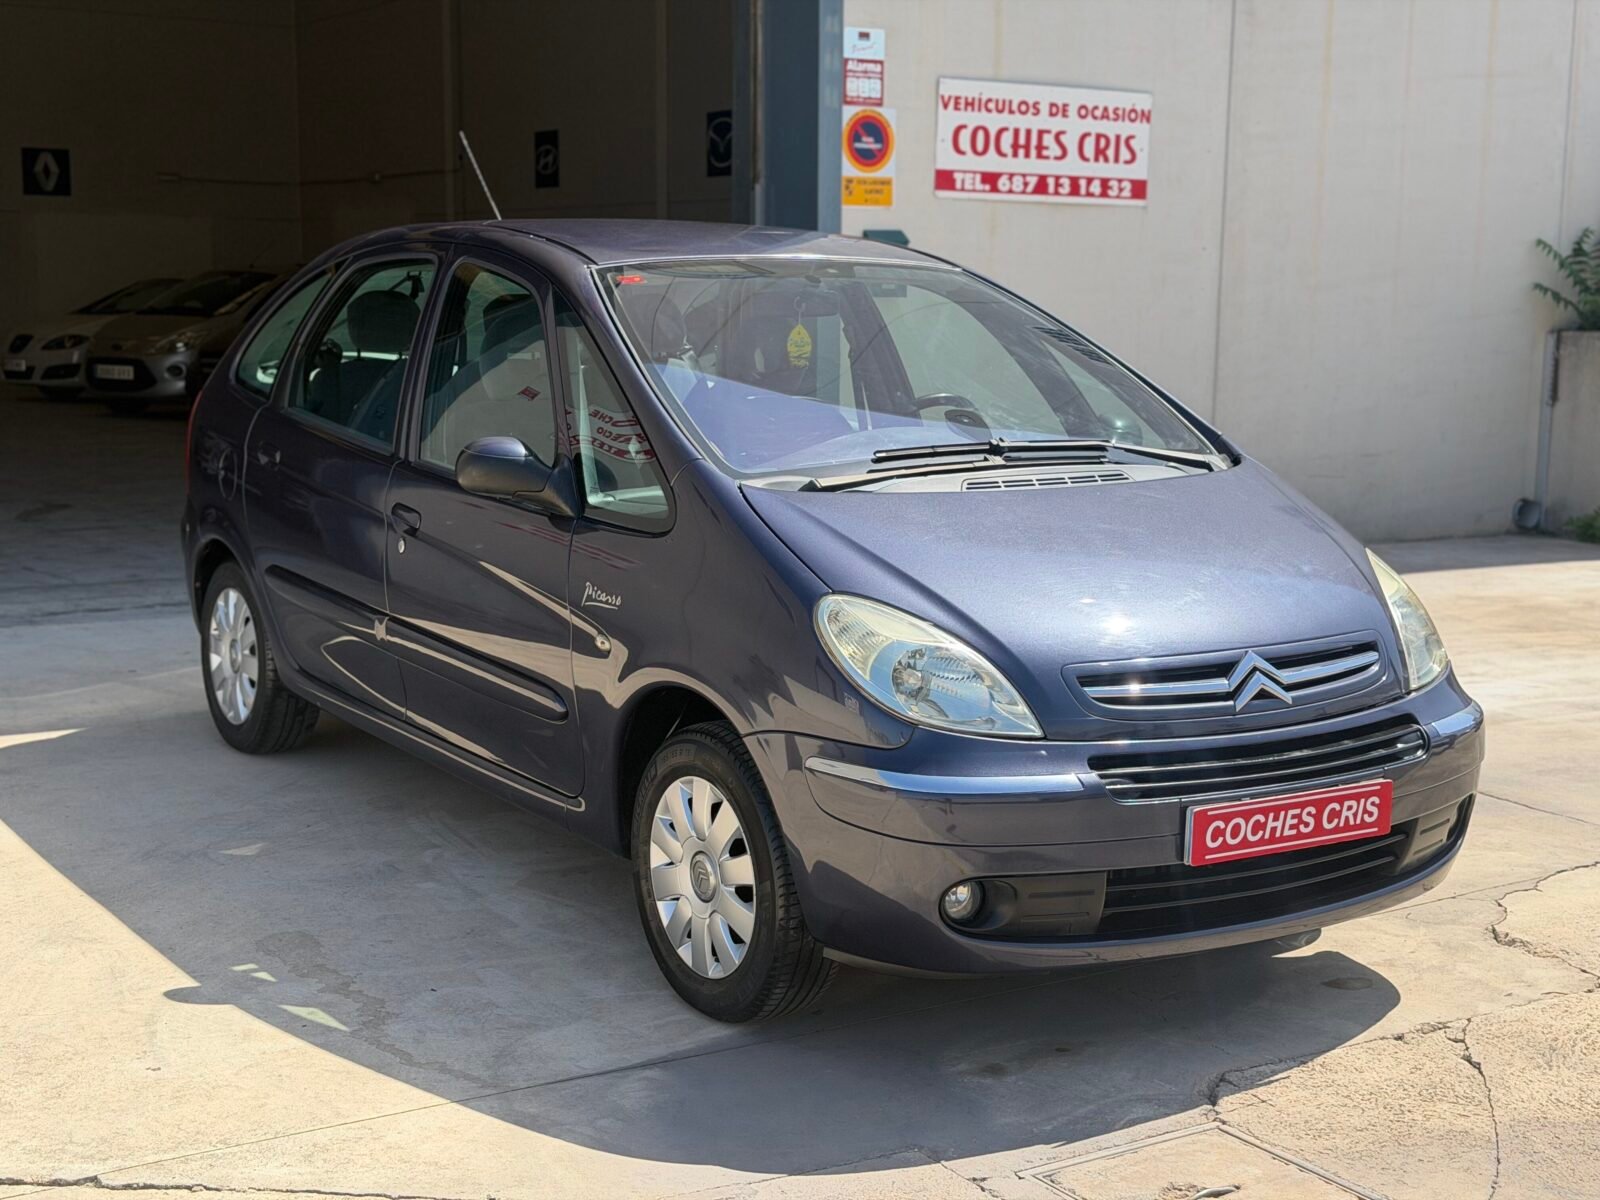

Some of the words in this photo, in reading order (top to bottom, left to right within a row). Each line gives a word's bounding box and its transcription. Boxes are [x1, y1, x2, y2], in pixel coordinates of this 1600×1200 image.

[940, 92, 1041, 117] VEHÍCULOS
[1048, 102, 1070, 119] DE
[1077, 103, 1152, 125] OCASIÓN
[952, 124, 1068, 161] COCHES
[1077, 132, 1138, 165] CRIS
[953, 172, 991, 192] TEL.
[997, 174, 1039, 194] 687
[1046, 177, 1071, 196] 13
[1078, 178, 1102, 197] 14
[1107, 180, 1132, 198] 32
[581, 581, 622, 610] Picasso
[1205, 806, 1316, 849] COCHES
[1322, 796, 1380, 830] CRIS
